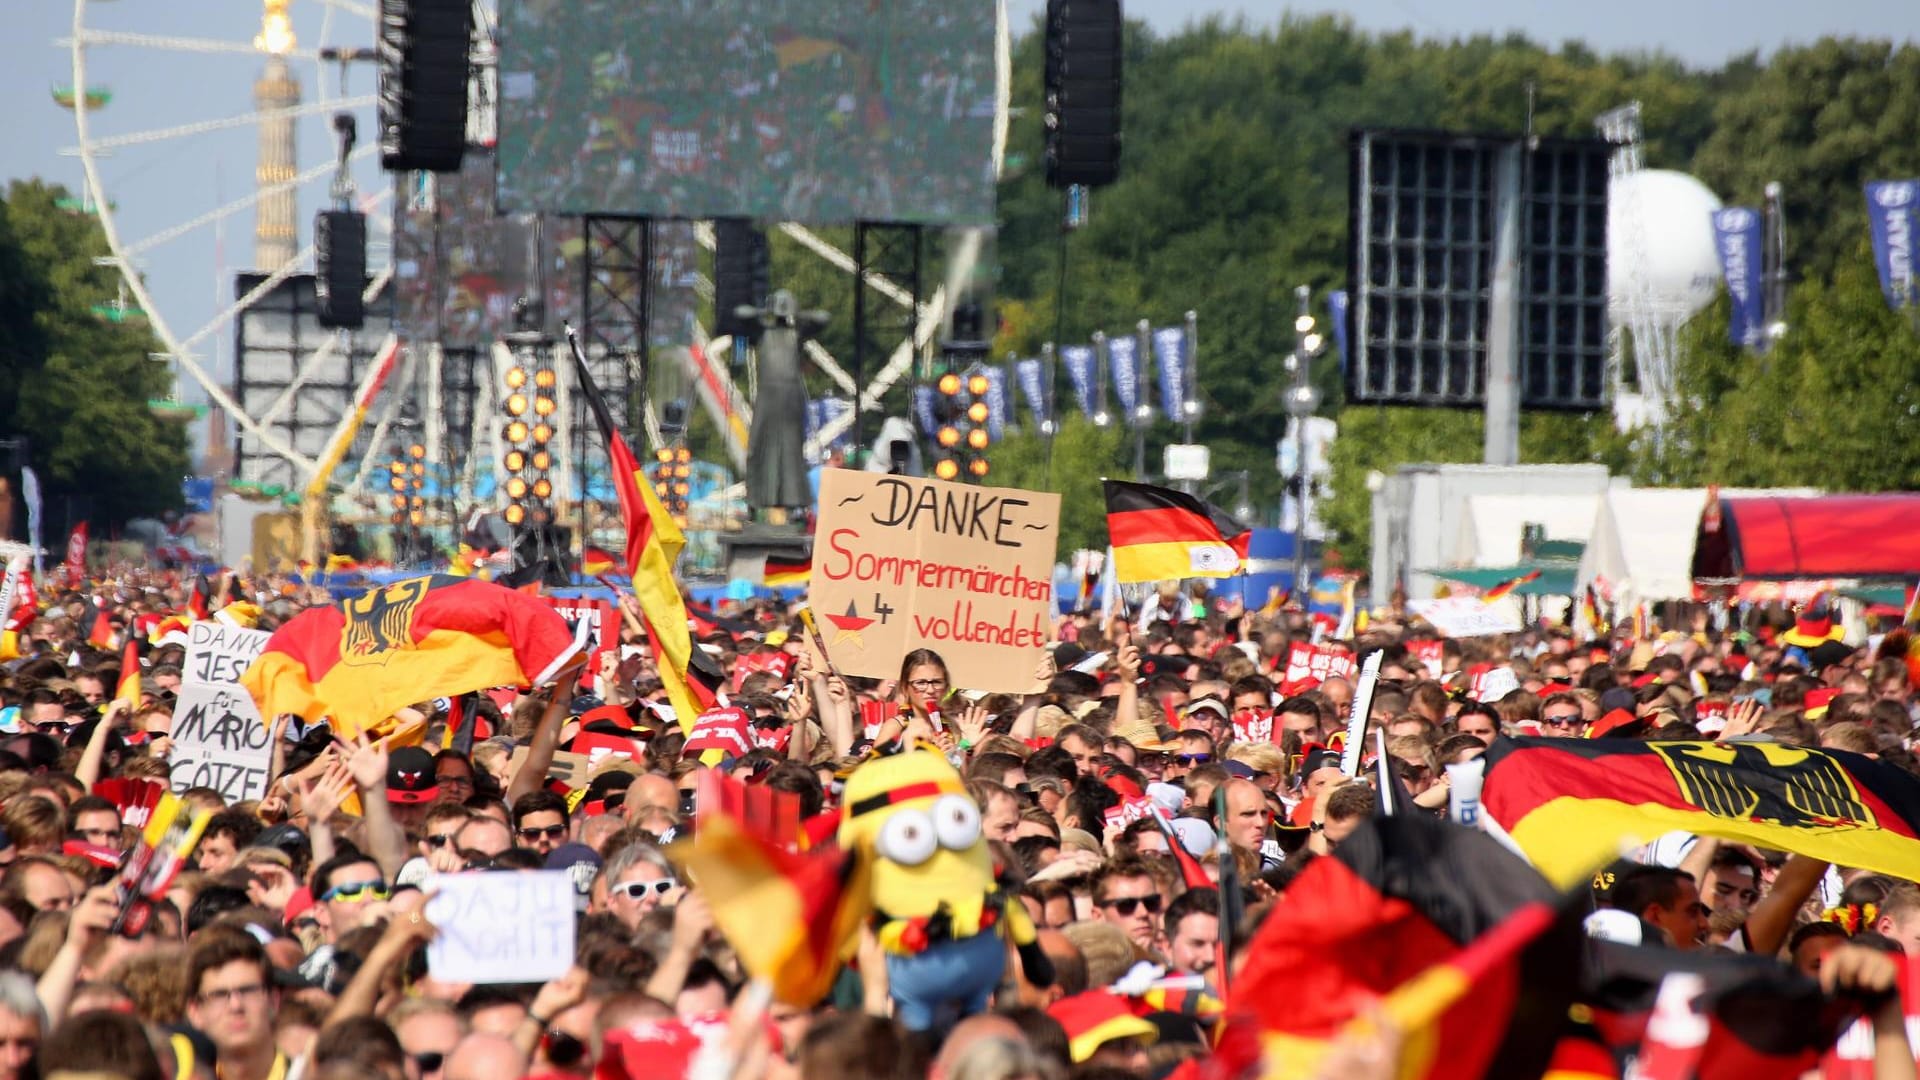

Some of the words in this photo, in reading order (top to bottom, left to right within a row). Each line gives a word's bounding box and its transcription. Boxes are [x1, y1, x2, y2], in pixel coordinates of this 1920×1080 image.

[871, 478, 1029, 547] DANKE
[823, 528, 1051, 601] Sommermärchen
[192, 624, 266, 655] DANK
[873, 592, 894, 624] 4
[914, 600, 1044, 648] vollendet
[195, 651, 251, 684] JES
[210, 690, 241, 714] für
[172, 703, 271, 751] MARIO
